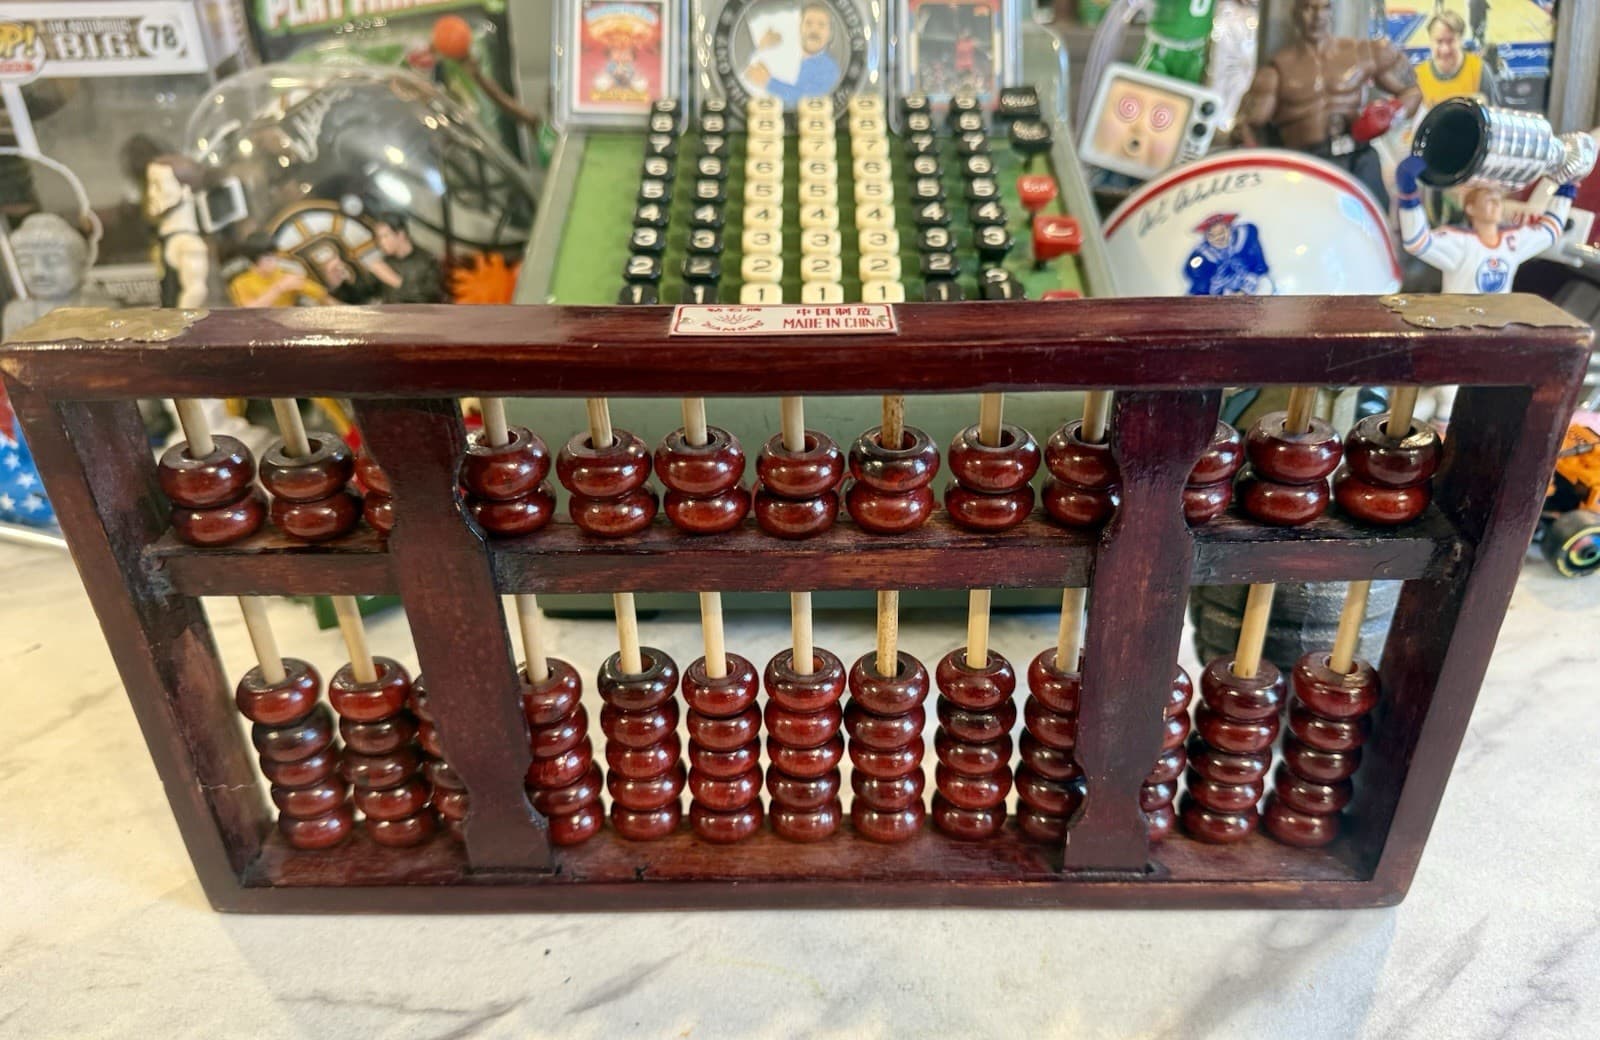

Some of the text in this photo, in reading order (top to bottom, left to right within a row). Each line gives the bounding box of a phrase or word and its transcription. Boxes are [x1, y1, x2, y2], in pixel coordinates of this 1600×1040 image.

[144, 24, 179, 50] 78
[650, 132, 984, 153] 7 7 7 7 7 7 7
[646, 155, 991, 175] 6 6 6 6 6 6 6
[642, 177, 995, 198] 5 5 5 5 5 5 5
[639, 201, 1000, 222] 4 4 4 4 4 4 4
[633, 226, 1006, 248] 3 3 3 3 3 3 3
[629, 255, 654, 274] 2
[690, 256, 712, 274] 2
[753, 259, 773, 273] 2
[812, 258, 830, 272] 2
[870, 258, 888, 272] 2
[930, 257, 950, 270] 2
[632, 285, 643, 303] 1
[694, 285, 704, 303] 1
[937, 284, 948, 300] 1
[1000, 280, 1011, 299] 1
[783, 317, 885, 329] MADE IN CHINA
